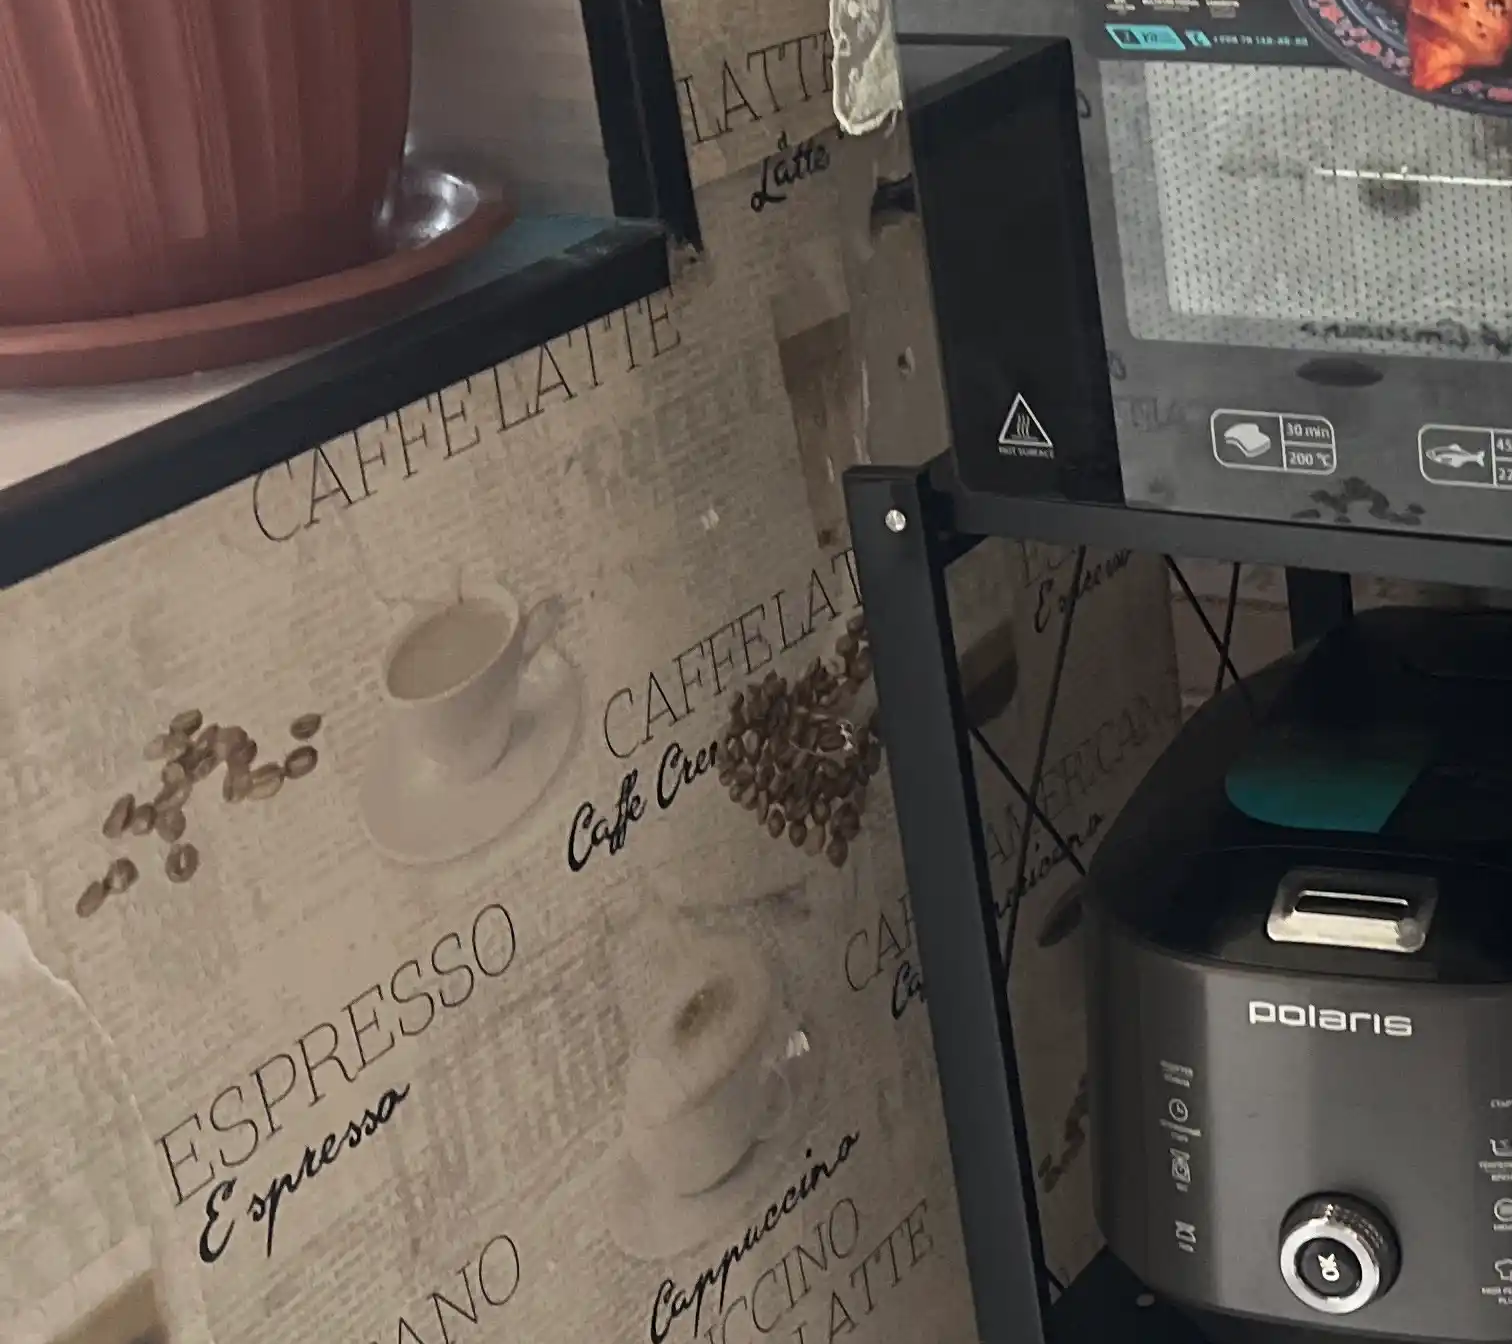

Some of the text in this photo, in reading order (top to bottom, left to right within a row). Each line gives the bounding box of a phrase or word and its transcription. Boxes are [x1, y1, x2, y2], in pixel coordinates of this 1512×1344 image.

[567, 768, 648, 873] Caffe
[154, 902, 518, 1209] ESPRESSO
[198, 1080, 412, 1263] Espresso
